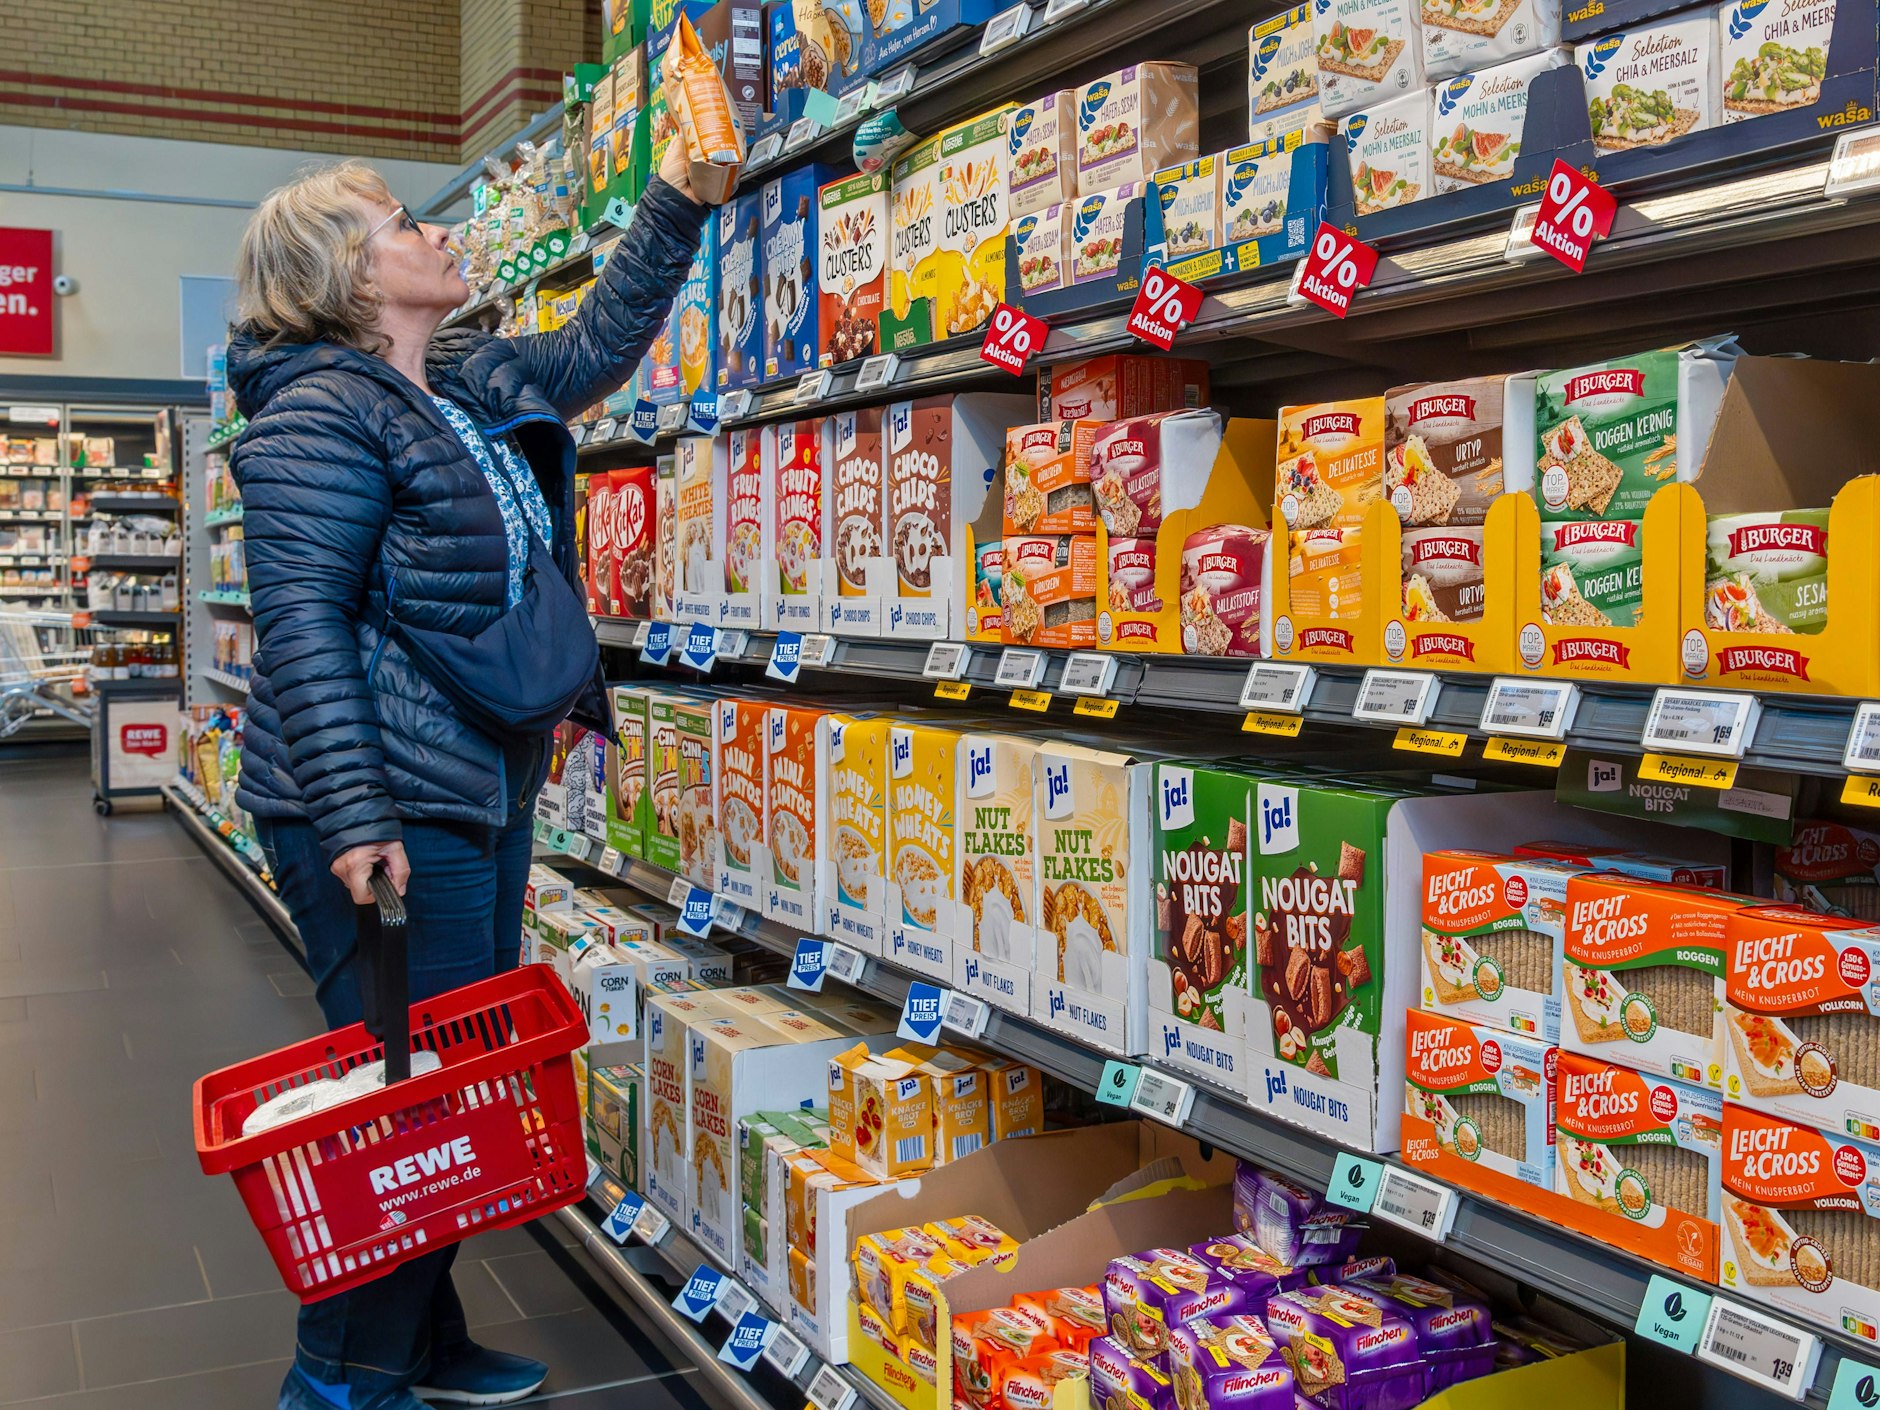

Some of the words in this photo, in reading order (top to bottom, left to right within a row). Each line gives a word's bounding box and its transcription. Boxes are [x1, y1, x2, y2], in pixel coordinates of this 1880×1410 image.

[1631, 34, 1683, 62] Selection
[1616, 64, 1639, 83] CHIA
[1641, 64, 1647, 76] &
[1650, 48, 1698, 75] MEERSALZ
[1087, 87, 1109, 103] wasa
[1479, 75, 1524, 99] Selection
[1374, 117, 1408, 139] Selection
[1362, 142, 1382, 157] MOHN
[1384, 143, 1388, 152] &
[1389, 130, 1421, 149] MEERSALZ
[765, 186, 778, 215] ja!
[1550, 173, 1593, 237] %
[945, 193, 998, 238] CLUSTERS
[1535, 221, 1583, 260] Aktion
[1317, 233, 1357, 288] %
[1145, 276, 1183, 323] %
[1303, 275, 1347, 308] Aktion
[995, 310, 1030, 352] %
[1131, 313, 1173, 341] Aktion
[984, 342, 1023, 368] Aktion
[1579, 373, 1633, 395] BURGER
[892, 408, 908, 445] ja!
[1595, 422, 1633, 450] ROGGEN
[1637, 409, 1673, 437] KERNIG
[1027, 432, 1051, 447] BURGER
[1455, 438, 1481, 462] URTYP
[839, 457, 879, 485] CHOCO
[894, 450, 938, 482] CHOCO
[1328, 449, 1377, 478] DELIKATESSE
[780, 469, 819, 500] FRUIT
[1546, 474, 1562, 485] TOP
[680, 481, 710, 504] WHITE
[1570, 523, 1626, 542] BURGER
[1746, 528, 1814, 550] BURGER
[1424, 541, 1470, 560] BURGER
[1750, 553, 1763, 562] Das
[1765, 553, 1804, 562] Landknäcke
[1216, 590, 1259, 615] BALLASTSTOFF
[891, 604, 902, 632] ja!
[906, 611, 921, 626] CHOCO
[922, 612, 936, 627] CHIPS
[690, 645, 710, 653] PREIS
[691, 635, 712, 646] TIEF
[779, 643, 798, 655] TIEF
[1522, 632, 1540, 644] TOP
[1567, 642, 1619, 662] BURGER
[1733, 650, 1796, 673] BURGER
[126, 728, 162, 740] REWE
[894, 737, 909, 770] ja!
[970, 748, 991, 789] ja!
[1659, 761, 1705, 779] Regional
[1047, 765, 1069, 810] ja!
[1163, 777, 1188, 820] ja!
[1629, 784, 1691, 801] NOUGAT
[896, 784, 943, 823] HONEY
[1645, 799, 1674, 812] BITS
[975, 808, 1011, 830] NUT
[1263, 796, 1291, 844] ja!
[893, 813, 950, 859] WHEATS
[965, 832, 1025, 856] FLAKES
[1055, 830, 1093, 854] NUT
[1044, 856, 1114, 883] FLAKES
[1163, 850, 1242, 884] NOUGAT
[1262, 876, 1357, 915] NOUGAT
[1428, 867, 1473, 903] LEICHT
[688, 901, 710, 912] TIEF
[1183, 885, 1222, 916] BITS
[1437, 884, 1495, 915] &CROSS
[830, 908, 840, 931] ja!
[842, 918, 856, 933] HONEY
[856, 922, 874, 940] WHEATS
[1428, 915, 1445, 927] MEIN
[1446, 910, 1492, 928] KNUSPERBROT
[1493, 919, 1523, 930] ROGGEN
[1571, 895, 1626, 932] LEICHT
[1286, 915, 1332, 950] BITS
[799, 951, 821, 964] TIEF
[1571, 945, 1589, 958] MEIN
[1591, 942, 1643, 960] KNUSPERBROT
[1677, 951, 1719, 966] ROGGEN
[1734, 933, 1797, 974] LEICHT
[798, 964, 820, 973] PREIS
[1747, 954, 1825, 990] &CROSS
[601, 976, 629, 988] CORN
[912, 998, 938, 1011] TIEF
[1734, 987, 1755, 1003] MEIN
[1759, 986, 1820, 1005] KNUSPERBROT
[1818, 1000, 1863, 1013] VOLLKORN
[911, 1012, 935, 1021] PREIS
[1050, 990, 1065, 1019] ja!
[1069, 1004, 1080, 1020] NUT
[1083, 1008, 1107, 1031] FLAKES
[1163, 1025, 1182, 1056] ja!
[1186, 1040, 1215, 1067] NOUGAT
[1216, 1052, 1234, 1072] BITS
[1411, 1028, 1452, 1058] LEICHT
[652, 1057, 675, 1080] CORN
[1106, 1091, 1123, 1101] Vegan
[1265, 1068, 1287, 1103] ja!
[1293, 1085, 1326, 1114] NOUGAT
[1328, 1098, 1349, 1122] BITS
[1470, 1082, 1497, 1093] ROGGEN
[1564, 1071, 1616, 1103] LEICHT
[695, 1088, 719, 1113] CORN
[892, 1102, 927, 1116] KNÄCKE
[1564, 1116, 1585, 1131] MEIN
[1587, 1119, 1635, 1134] KNUSPERBROT
[1637, 1132, 1671, 1144] ROGGEN
[1730, 1127, 1792, 1160] LEICHT
[369, 1135, 476, 1195] REWE
[379, 1166, 481, 1212] www.rewe.de
[1340, 1190, 1360, 1204] Vegan
[1730, 1175, 1752, 1192] MEIN
[1755, 1182, 1815, 1197] KNUSPERBROT
[618, 1203, 638, 1216] TIEF
[1814, 1199, 1859, 1210] VOLLKORN
[1679, 1255, 1702, 1270] VEGAN
[694, 1278, 716, 1291] TIEF
[1180, 1292, 1225, 1320] Filinchen
[738, 1327, 763, 1340] TIEF
[1357, 1326, 1402, 1352] Filinchen
[1653, 1322, 1680, 1341] Vegan
[1007, 1381, 1045, 1401] Filinchen
[1224, 1371, 1279, 1393] Filinchen
